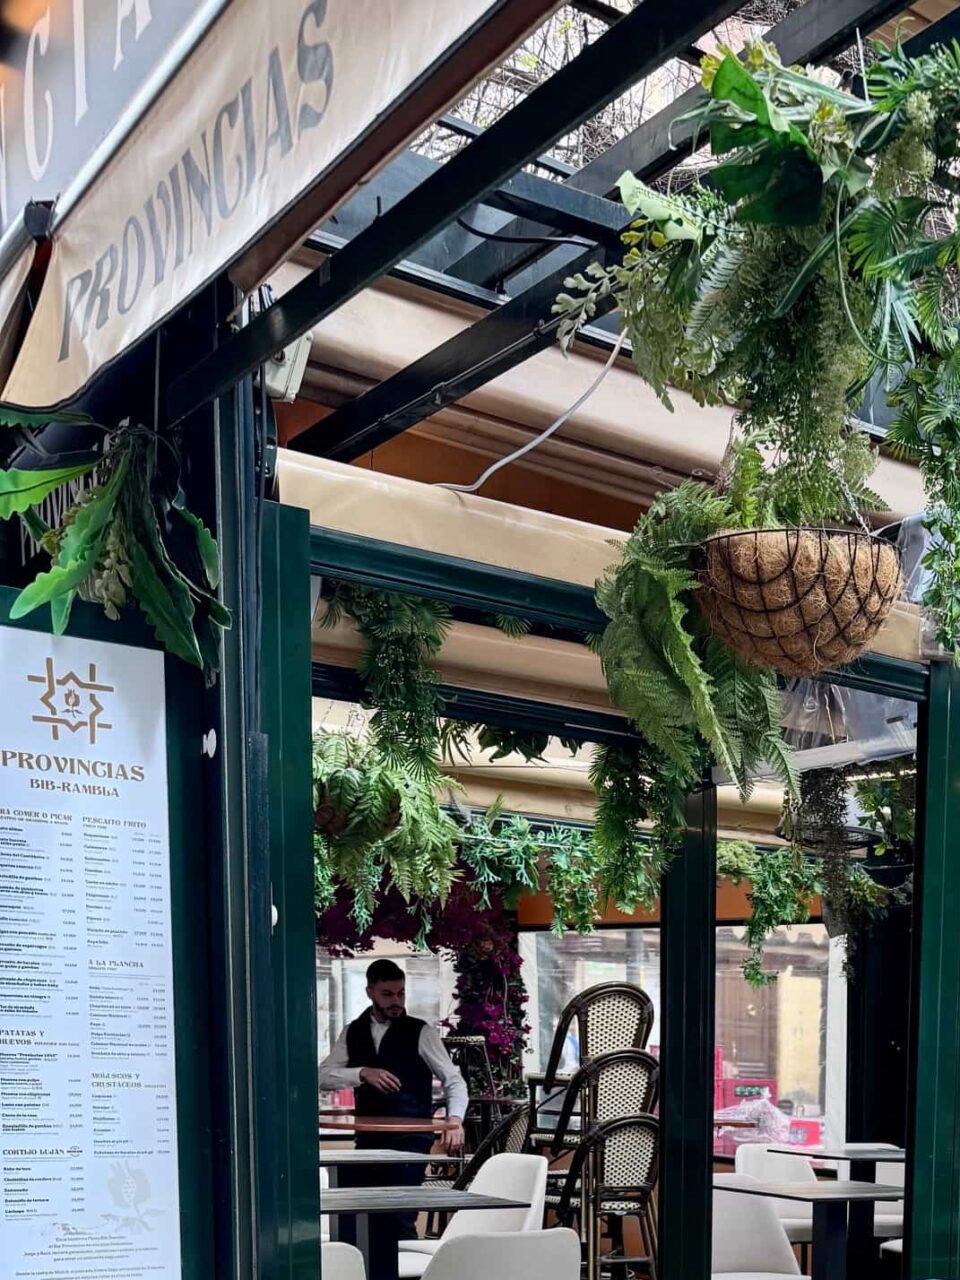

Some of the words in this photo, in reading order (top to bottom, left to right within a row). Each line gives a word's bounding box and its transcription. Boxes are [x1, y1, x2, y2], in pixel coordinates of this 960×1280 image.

[58, 0, 334, 363] PROVINCIAS
[1, 750, 145, 782] PROVINCIAS
[30, 778, 120, 798] BIB-RAMBLA
